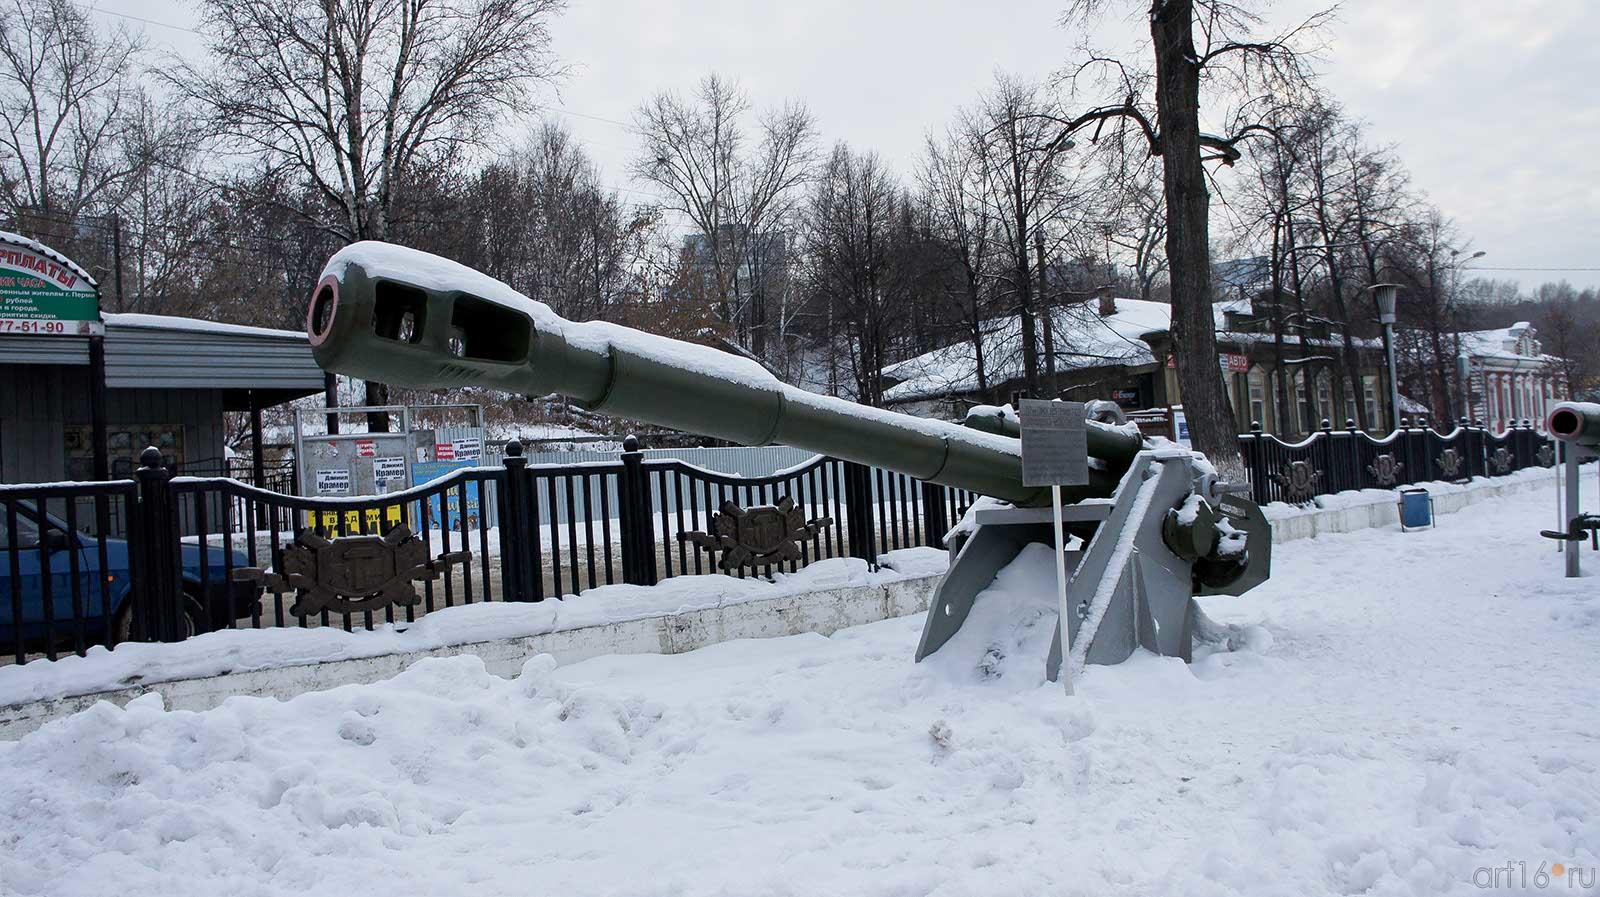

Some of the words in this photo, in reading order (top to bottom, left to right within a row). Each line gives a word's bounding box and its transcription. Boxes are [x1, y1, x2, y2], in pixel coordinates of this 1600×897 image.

[1229, 355, 1248, 367] АВТО
[454, 449, 480, 458] Крамер
[375, 469, 405, 477] Крамер
[318, 482, 349, 490] Крамер
